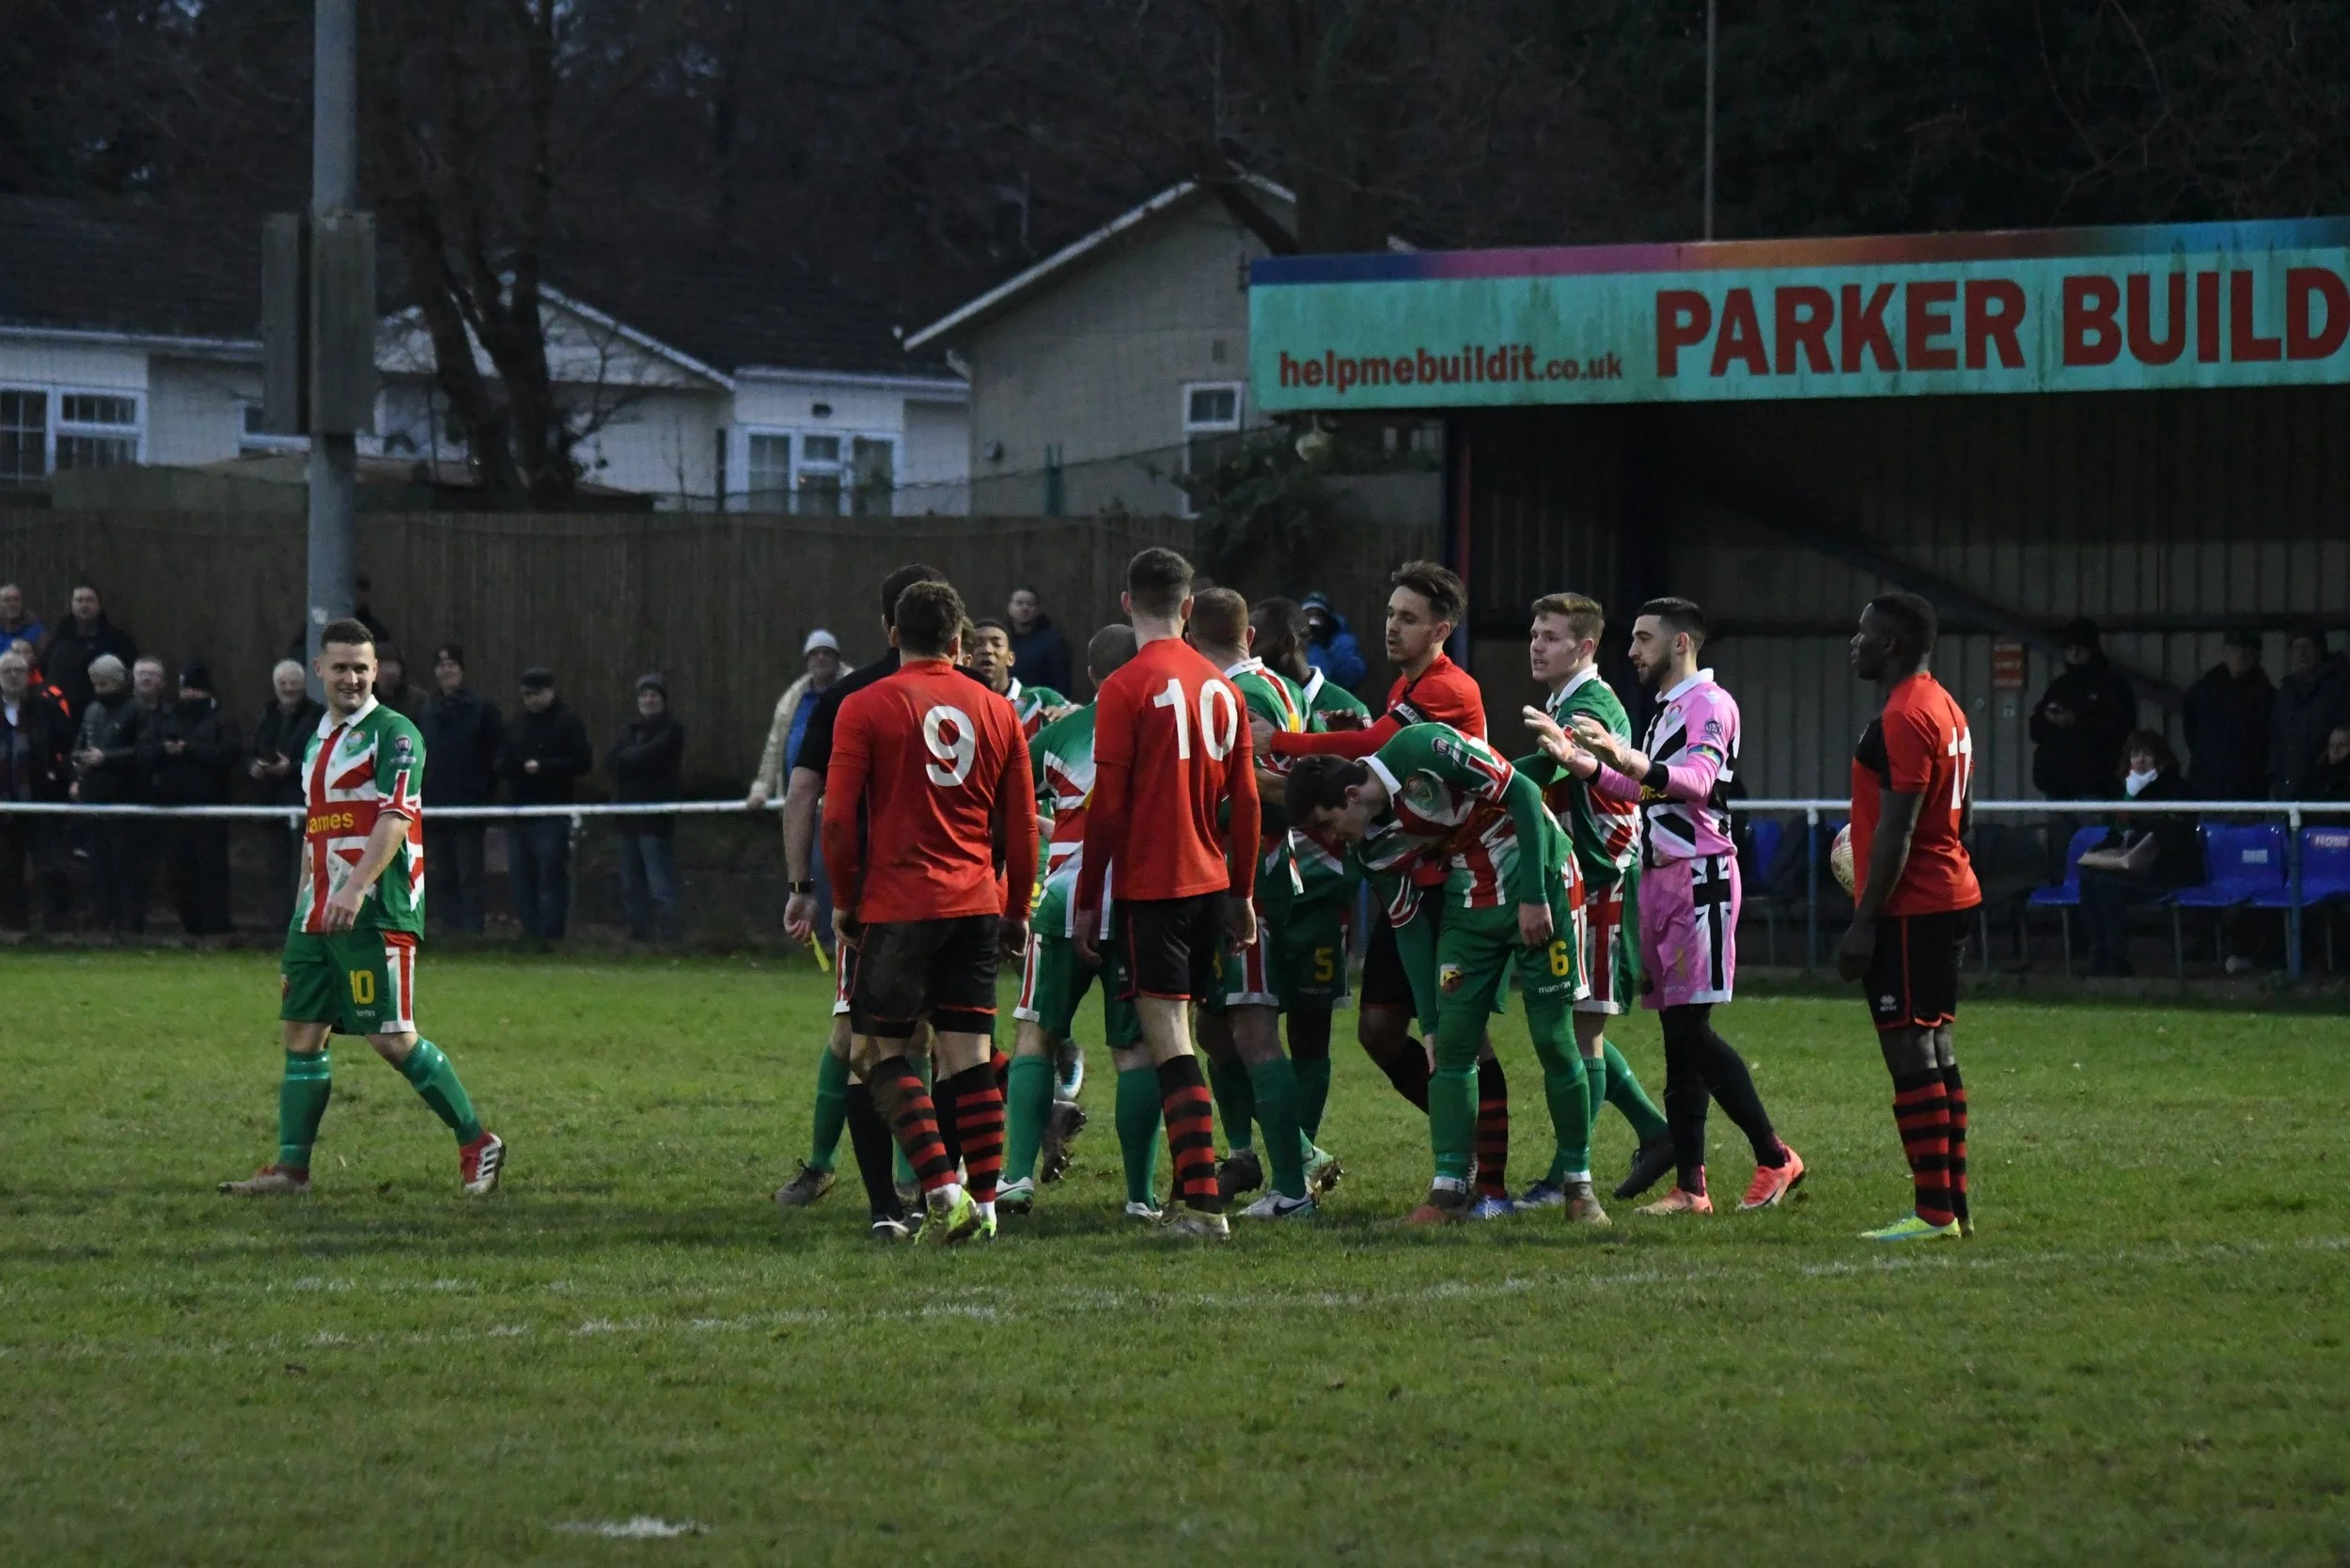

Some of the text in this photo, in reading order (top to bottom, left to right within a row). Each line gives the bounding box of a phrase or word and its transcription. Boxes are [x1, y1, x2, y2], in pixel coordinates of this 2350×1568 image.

[1656, 267, 2350, 378] PARKER BUILD
[1279, 345, 1622, 394] helpmebuildit.co.uk
[1153, 678, 1238, 761] 10
[924, 705, 976, 787] 9
[1314, 947, 1335, 982] 5
[1549, 940, 1569, 978] 6
[349, 969, 375, 1005] 10
